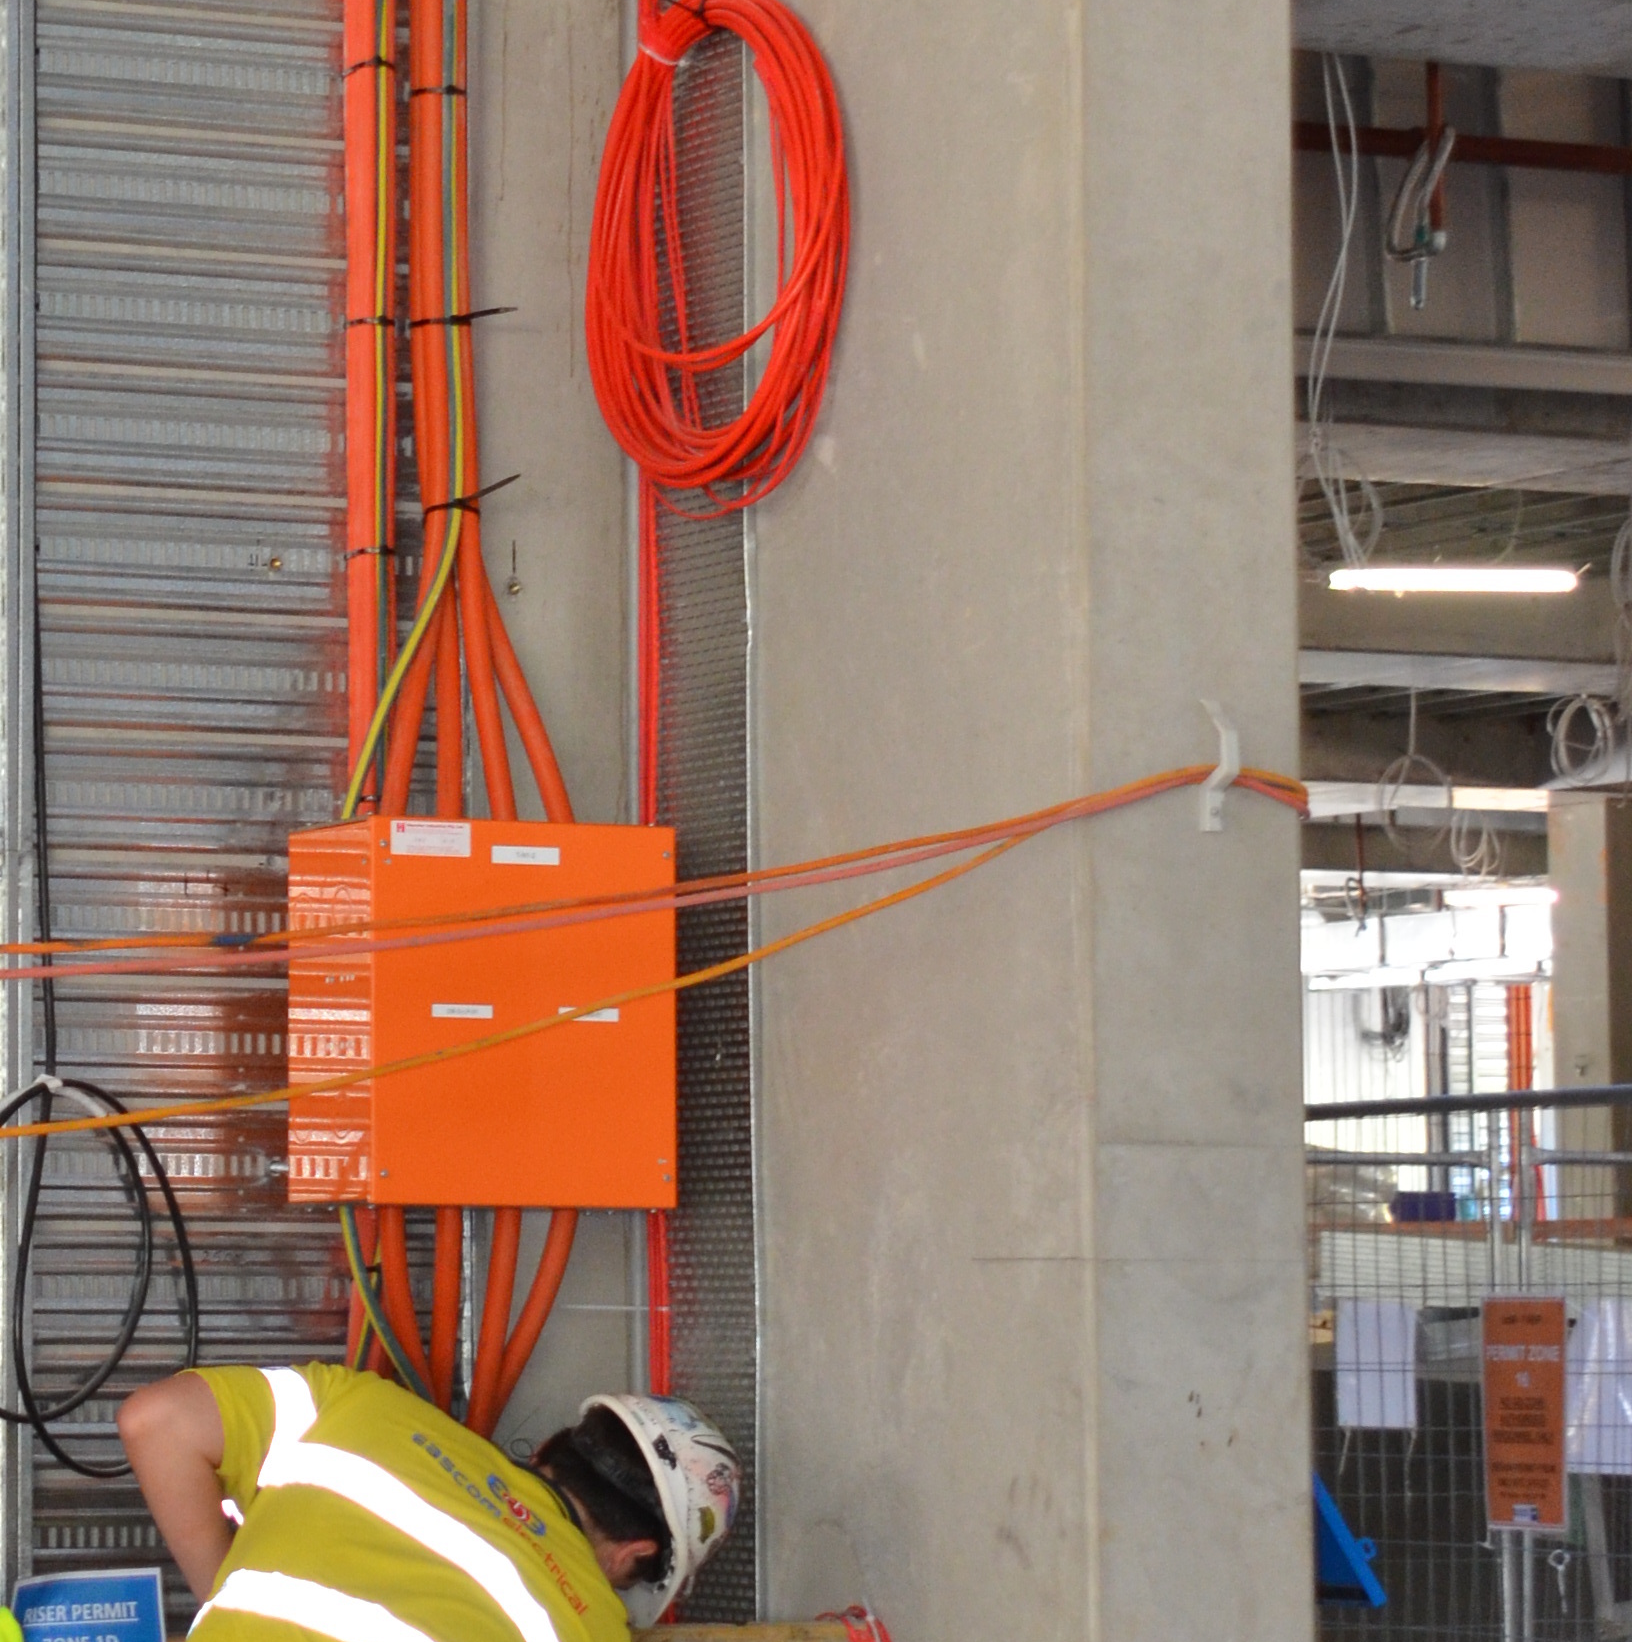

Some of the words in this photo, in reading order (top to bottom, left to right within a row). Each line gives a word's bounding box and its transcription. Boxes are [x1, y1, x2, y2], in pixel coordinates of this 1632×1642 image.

[501, 1517, 588, 1616] electrical
[23, 1604, 68, 1624] RISER
[71, 1601, 138, 1621] PERMIT
